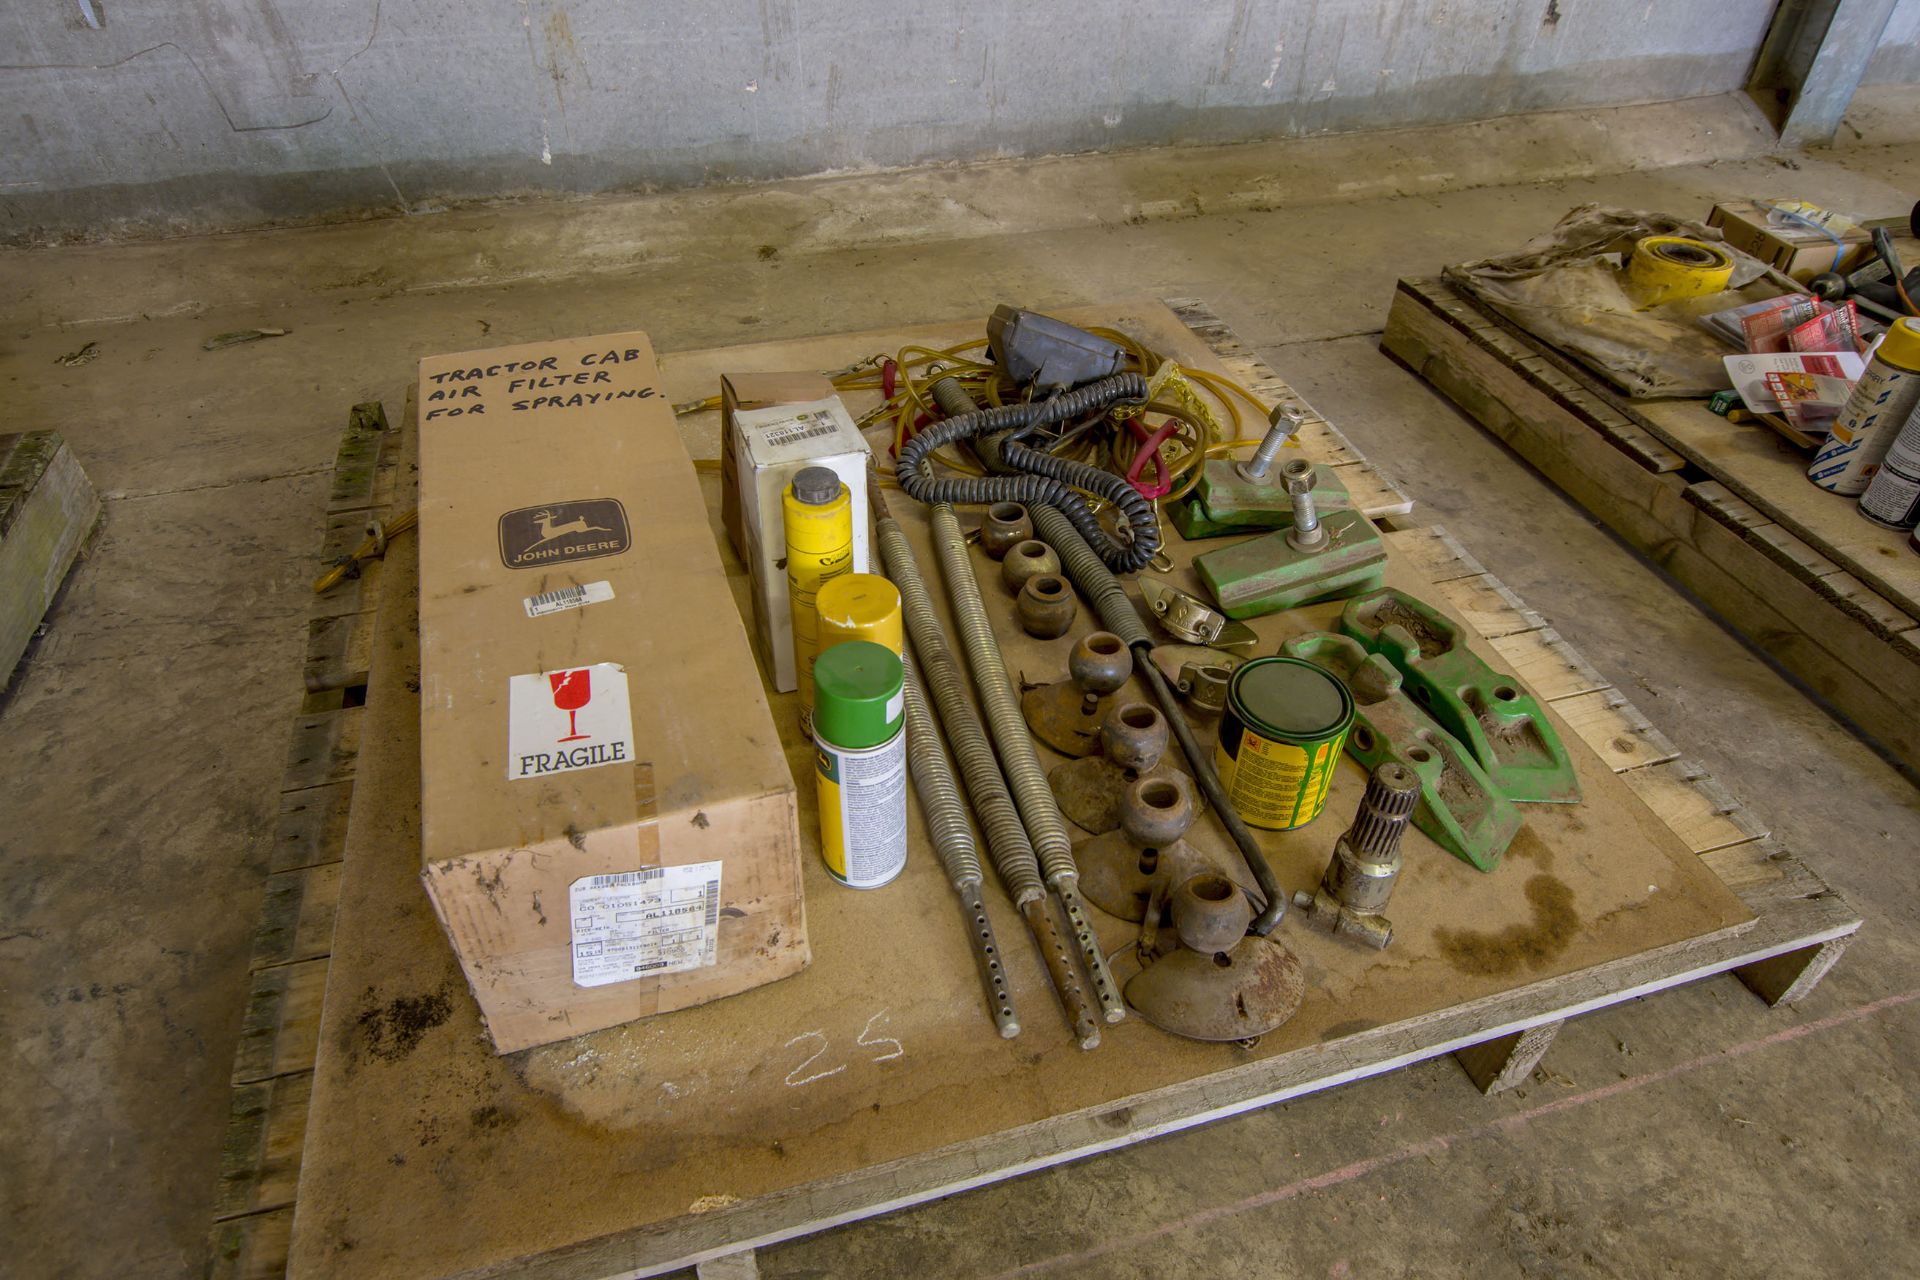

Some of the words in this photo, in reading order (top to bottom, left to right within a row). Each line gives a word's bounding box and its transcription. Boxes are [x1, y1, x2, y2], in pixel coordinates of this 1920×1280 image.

[430, 357, 557, 384] TRACTOR
[580, 349, 640, 366] CAB
[428, 385, 482, 401] AIR
[508, 371, 612, 393] FILTER
[426, 404, 485, 421] FOR
[512, 387, 666, 411] SPRAYING.
[514, 548, 560, 563] JOHN
[564, 540, 620, 554] DEERE
[520, 741, 626, 775] FRAGILE
[783, 1006, 903, 1087] 25
